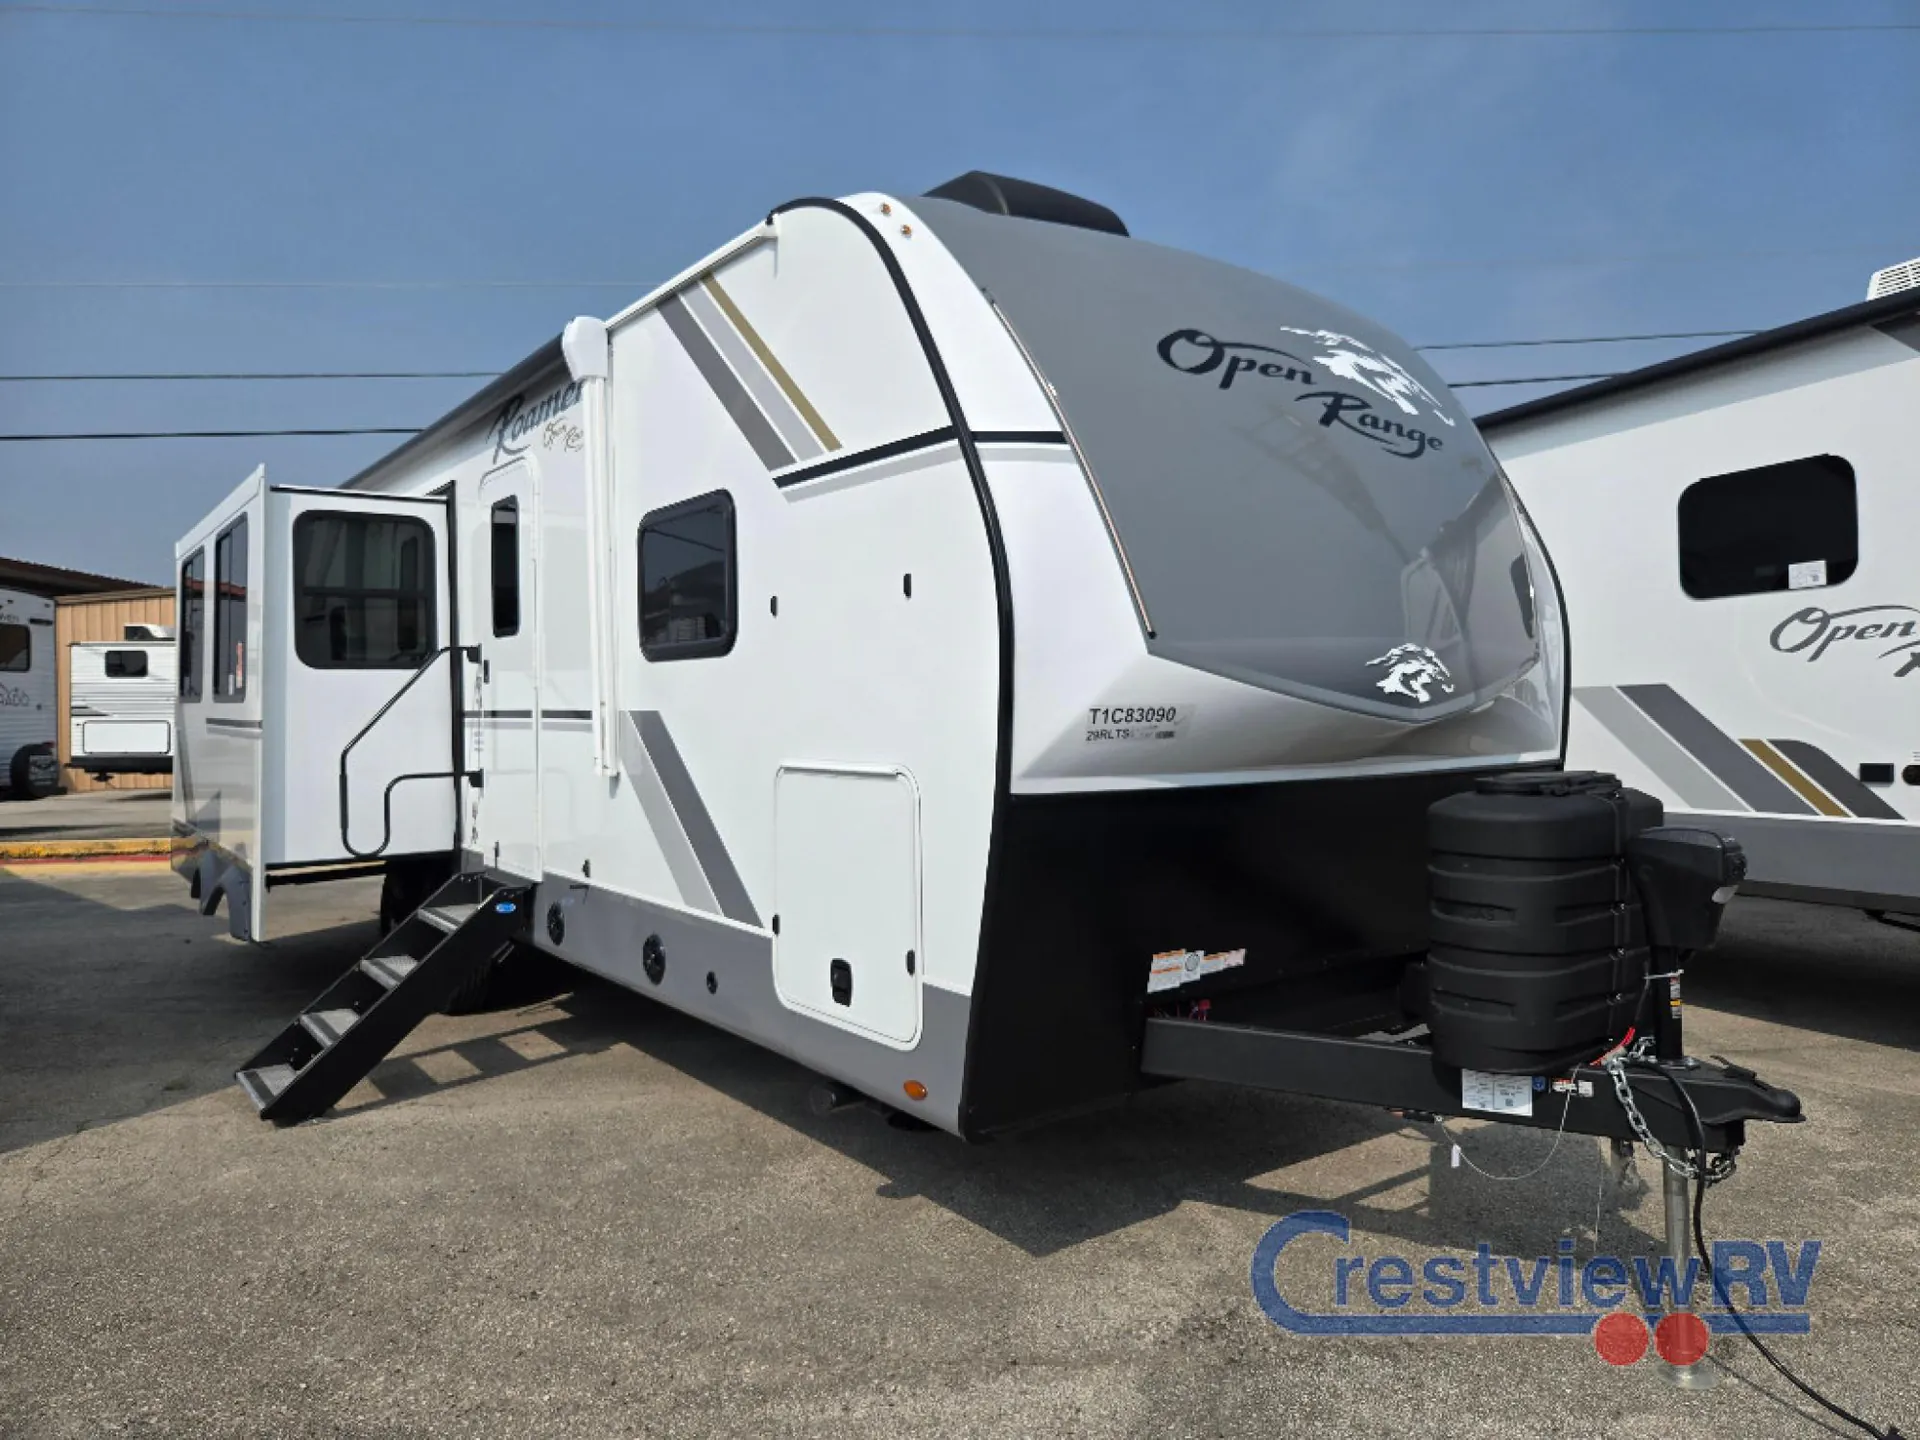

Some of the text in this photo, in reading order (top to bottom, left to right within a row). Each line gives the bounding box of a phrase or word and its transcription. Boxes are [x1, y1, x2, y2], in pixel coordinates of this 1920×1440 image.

[1157, 328, 1317, 390] Open
[1294, 391, 1443, 459] Range
[1769, 605, 1920, 663] Open
[1089, 707, 1176, 725] T1C83090
